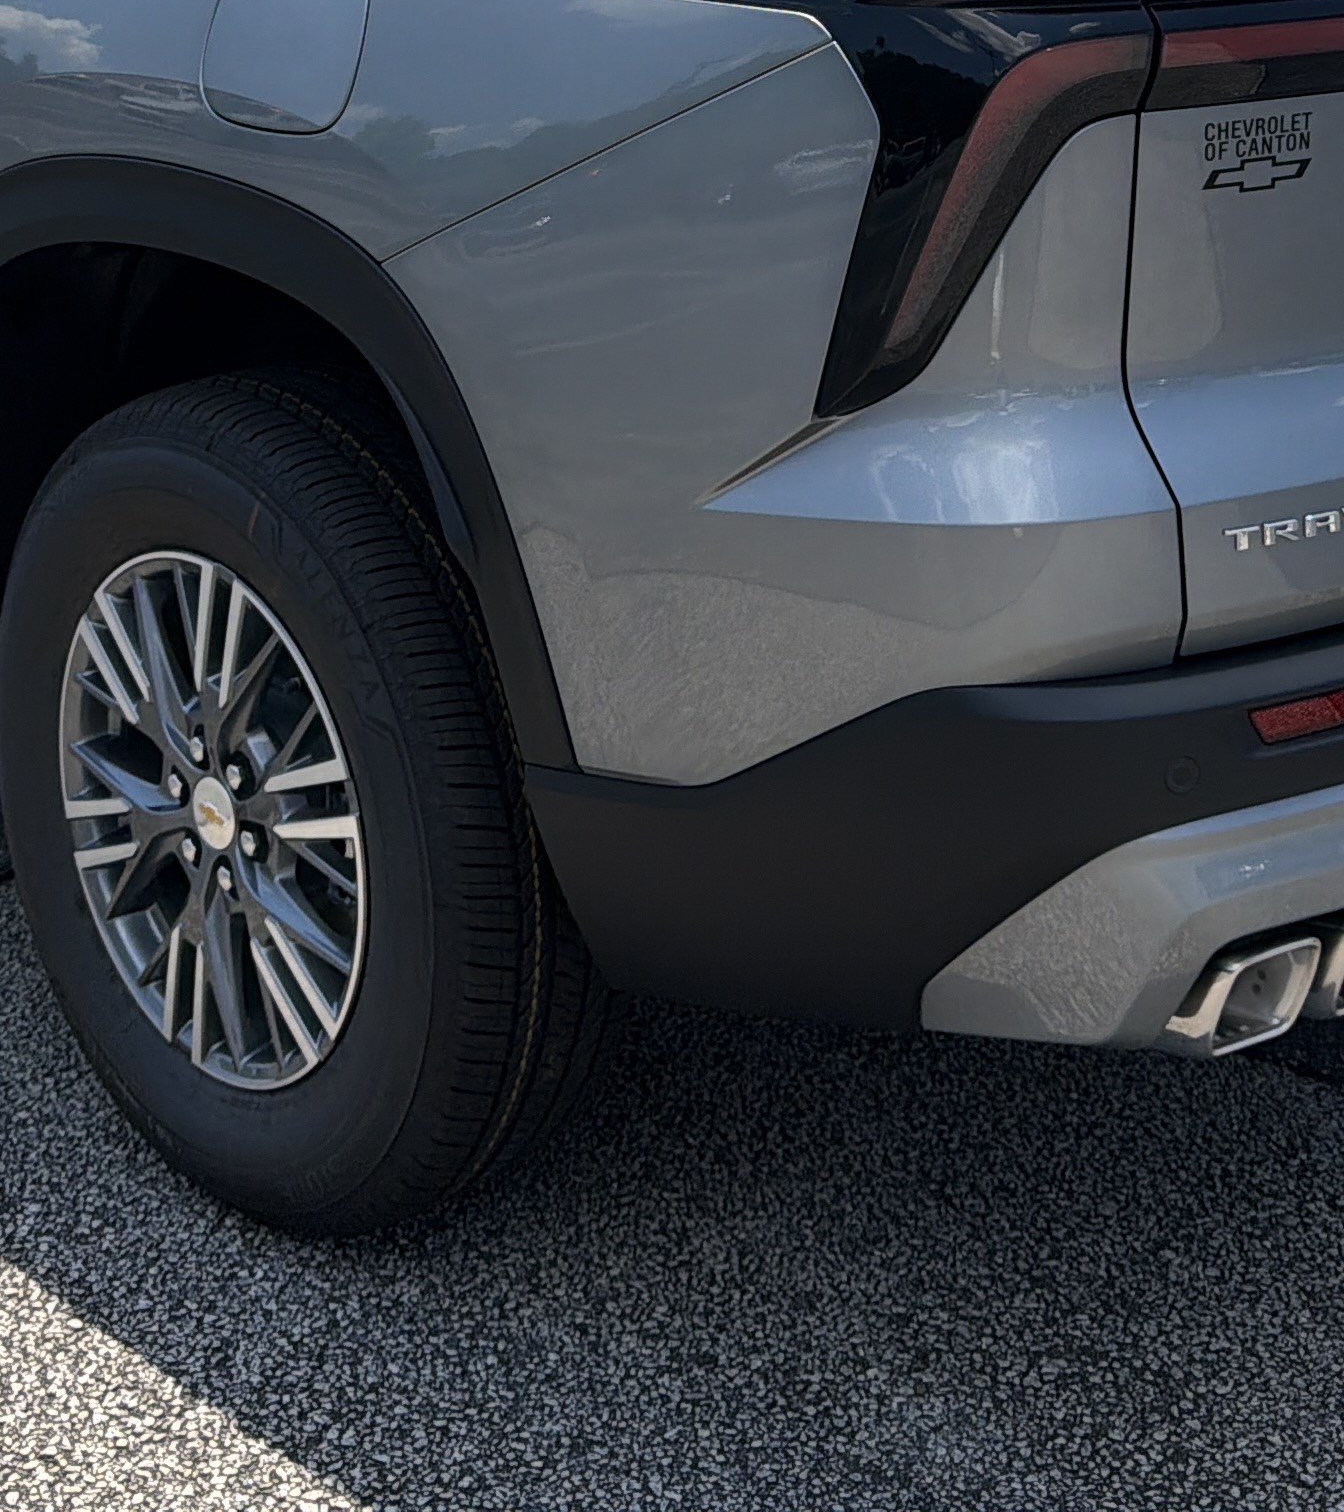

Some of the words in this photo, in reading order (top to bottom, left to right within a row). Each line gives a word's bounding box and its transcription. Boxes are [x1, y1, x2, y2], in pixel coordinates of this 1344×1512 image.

[1204, 111, 1313, 141] CHEVROLET
[1204, 141, 1229, 161] OF
[1235, 131, 1311, 157] CANTON
